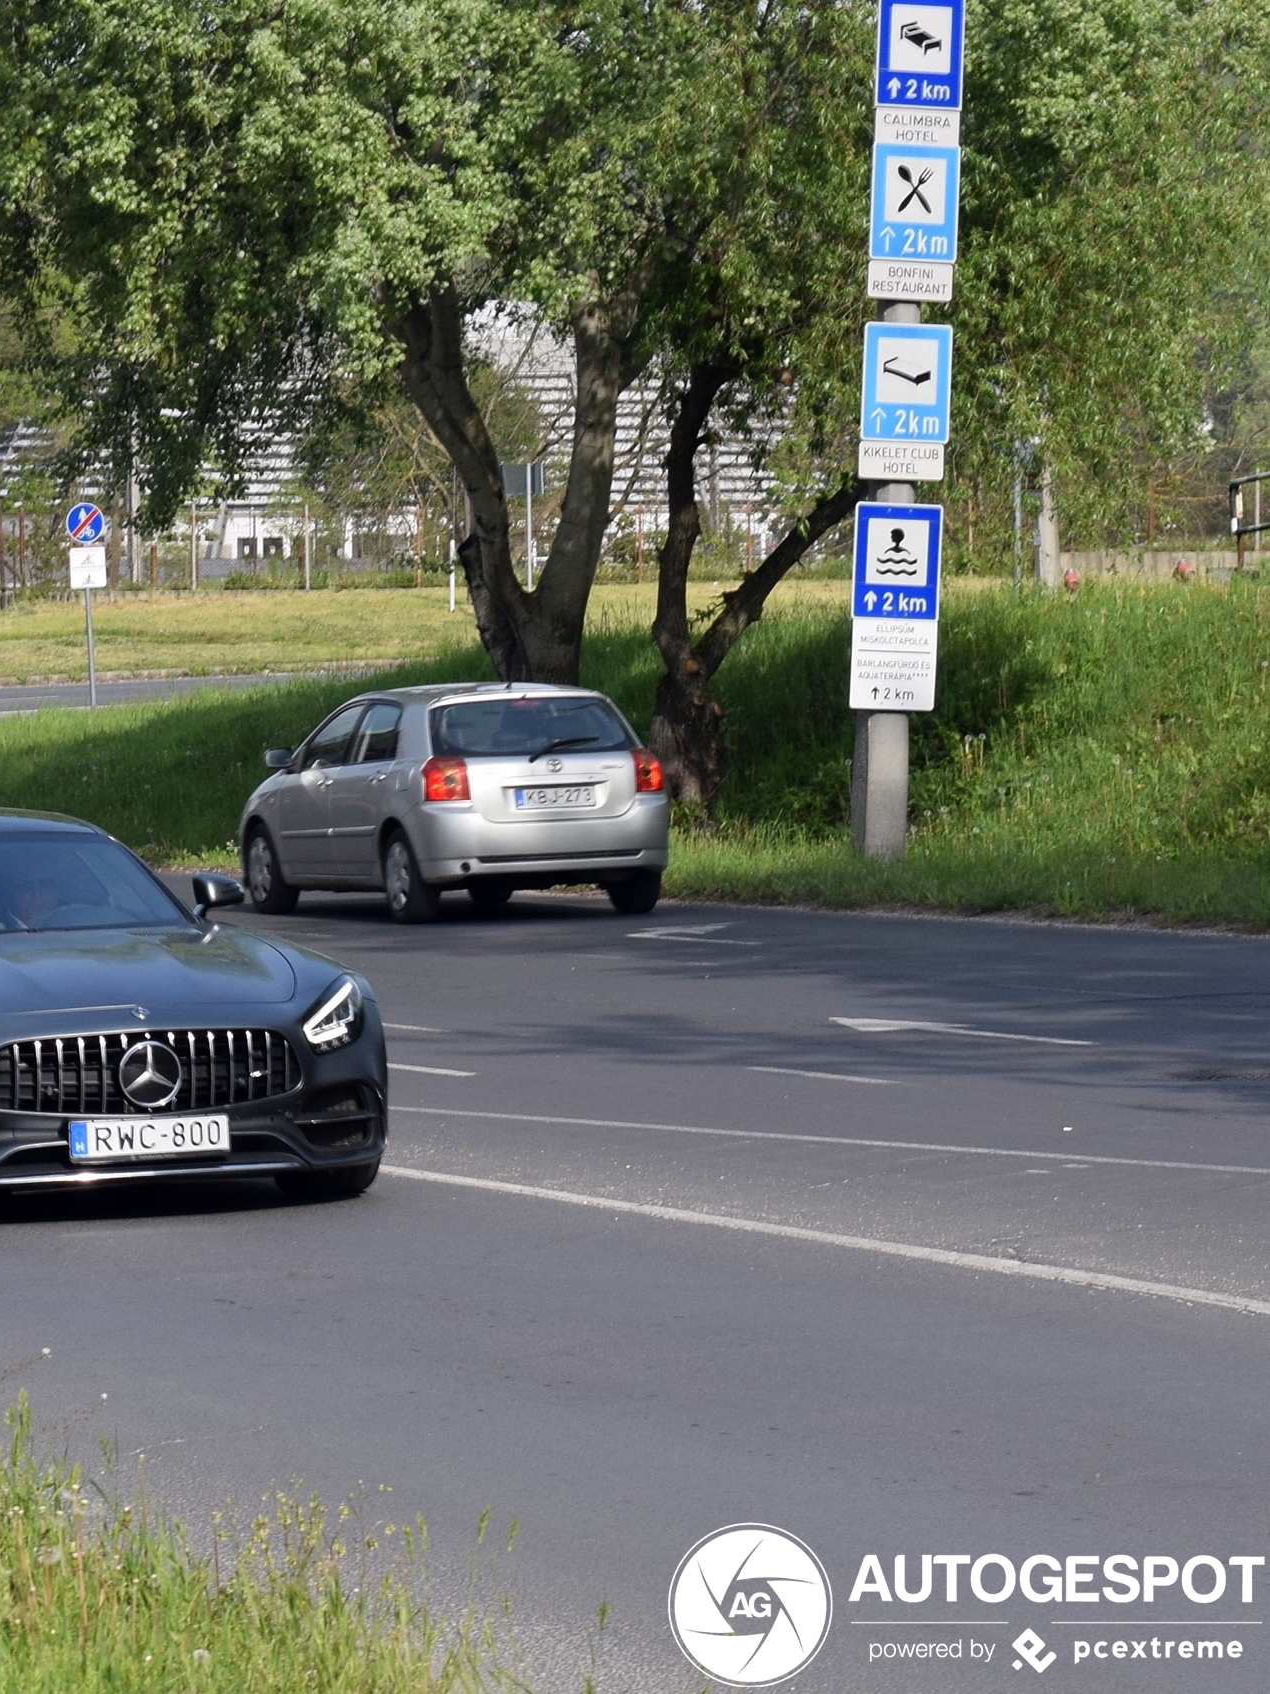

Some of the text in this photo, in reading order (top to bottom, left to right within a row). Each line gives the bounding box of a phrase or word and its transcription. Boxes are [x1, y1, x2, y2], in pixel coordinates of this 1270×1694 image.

[905, 78, 950, 101] 2 km
[883, 113, 951, 128] CALIMBRA
[895, 129, 938, 142] HOTEL
[888, 266, 934, 279] BONFINI
[872, 280, 947, 294] RESTAURANT
[863, 446, 939, 460] KIKELET CLUB
[883, 462, 918, 474] HOTEL
[882, 591, 927, 613] 2 km
[860, 636, 929, 645] MISKOLCTAPOLCA
[883, 687, 914, 700] 2 km
[526, 788, 591, 804] KBJ-273
[94, 1119, 221, 1151] RWC-800
